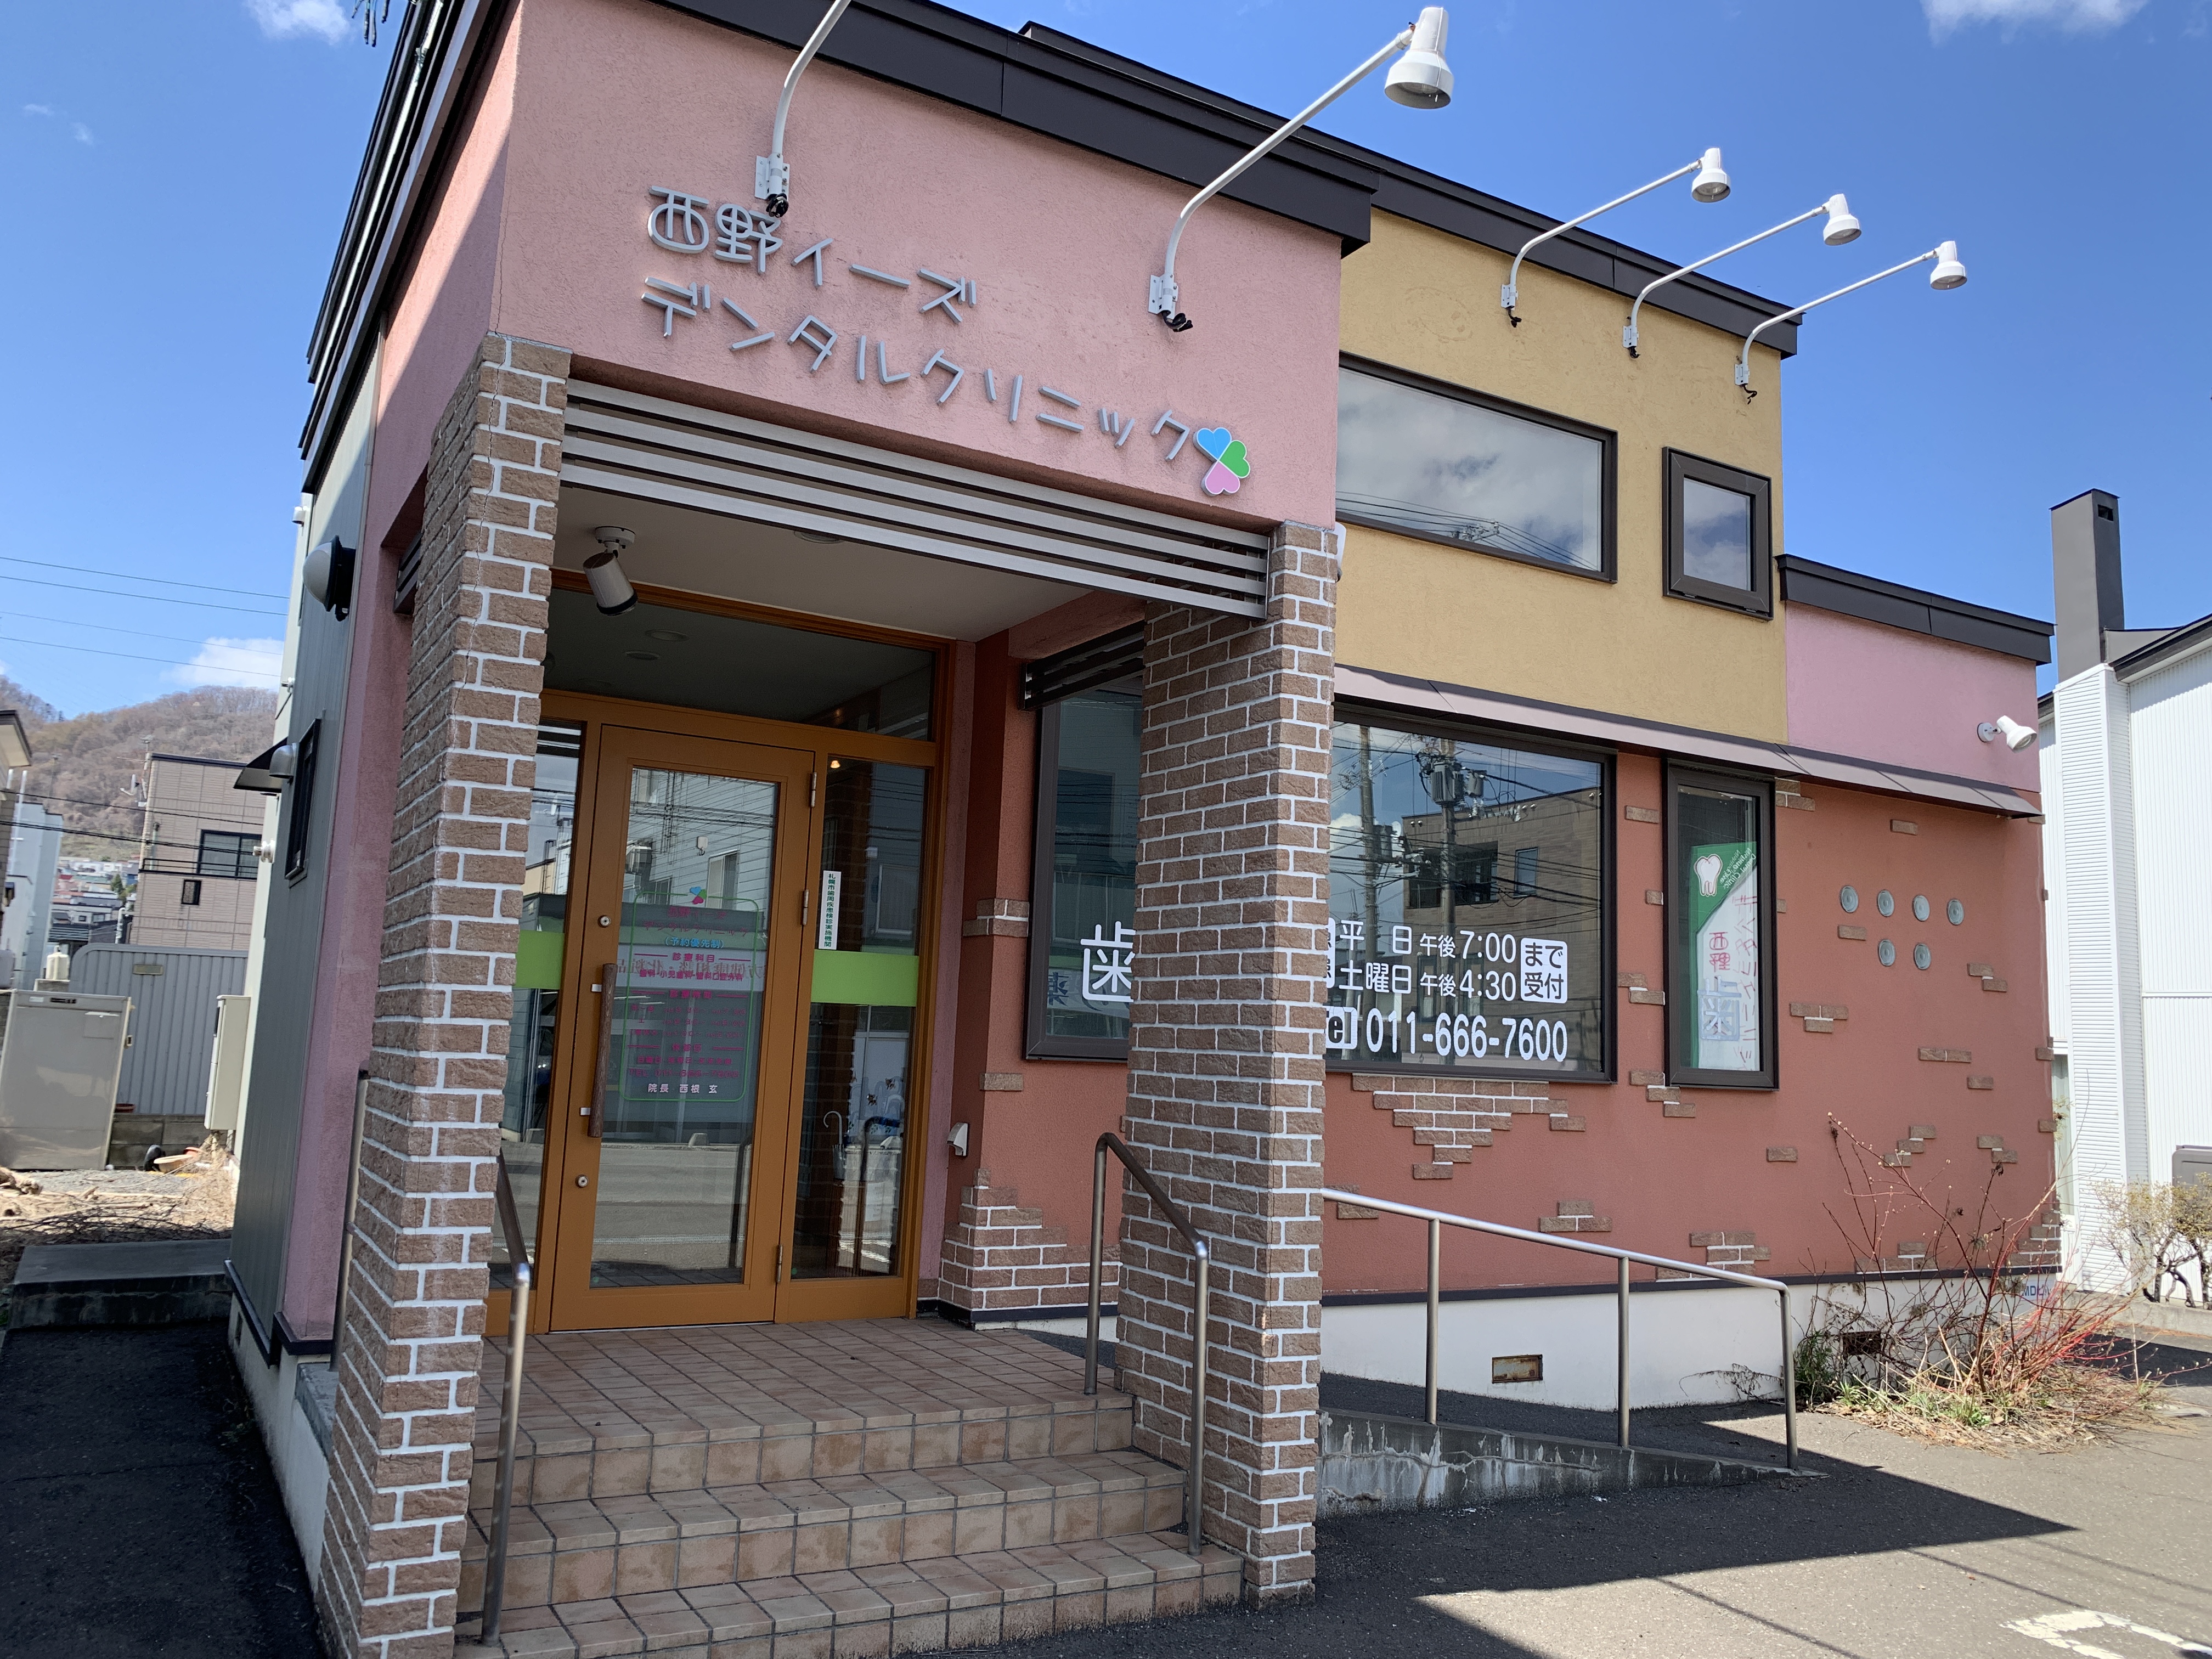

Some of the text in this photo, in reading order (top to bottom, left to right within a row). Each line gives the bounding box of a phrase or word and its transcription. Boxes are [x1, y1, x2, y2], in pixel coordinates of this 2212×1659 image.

[647, 185, 977, 324] 西野イーズ
[641, 276, 1192, 462] デンタルクリニック
[824, 873, 836, 947] 札幌市歯周疾患検診実施機関
[1080, 921, 1136, 1003] 歯
[1327, 1008, 1567, 1063] el 011-666-7600
[648, 1084, 669, 1093] 院長
